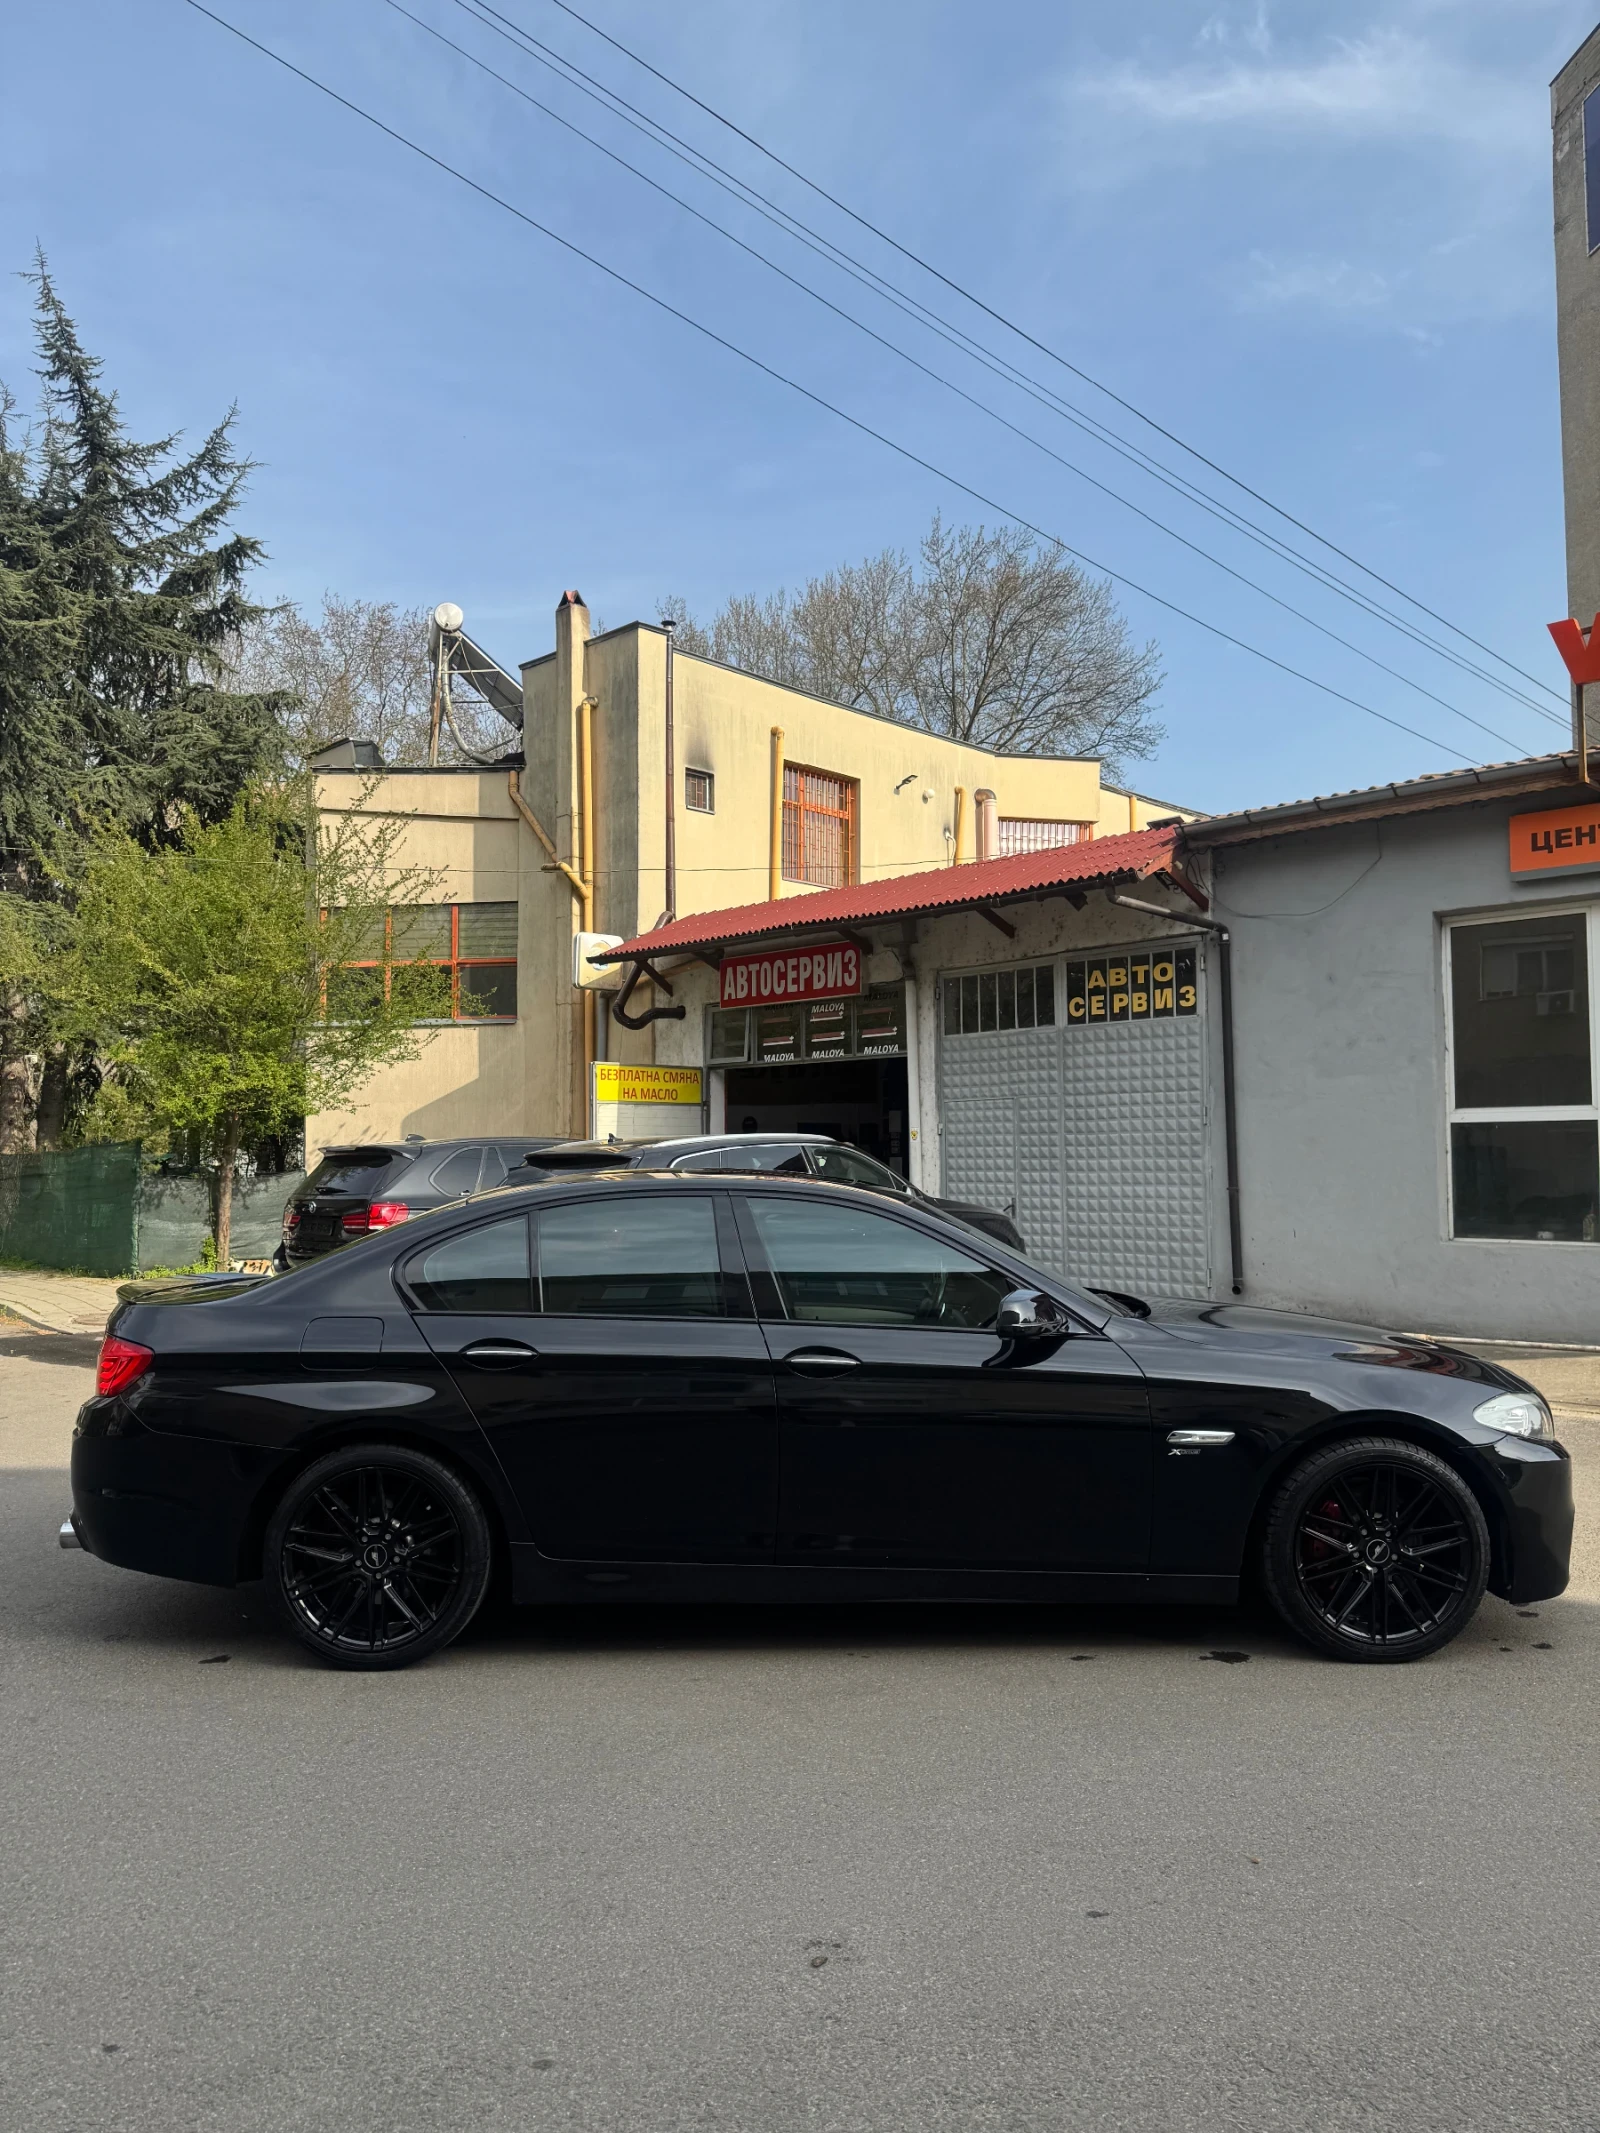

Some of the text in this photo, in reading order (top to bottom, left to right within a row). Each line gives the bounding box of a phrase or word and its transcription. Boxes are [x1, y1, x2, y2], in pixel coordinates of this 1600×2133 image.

[1531, 824, 1600, 853] ЦЕН
[724, 949, 857, 1000] АВТОСЕРВИЗ
[1088, 962, 1174, 989] АВТО
[811, 1003, 845, 1013] MALOYA
[1069, 985, 1196, 1017] СЕРВИЗ
[811, 1049, 845, 1059] MALOYA
[863, 1044, 899, 1055] MALOYA
[763, 1053, 795, 1063] MALOYA
[600, 1068, 700, 1084] БЕЗПЛАТНА СМЯНА
[623, 1088, 678, 1100] НА МАСЛО
